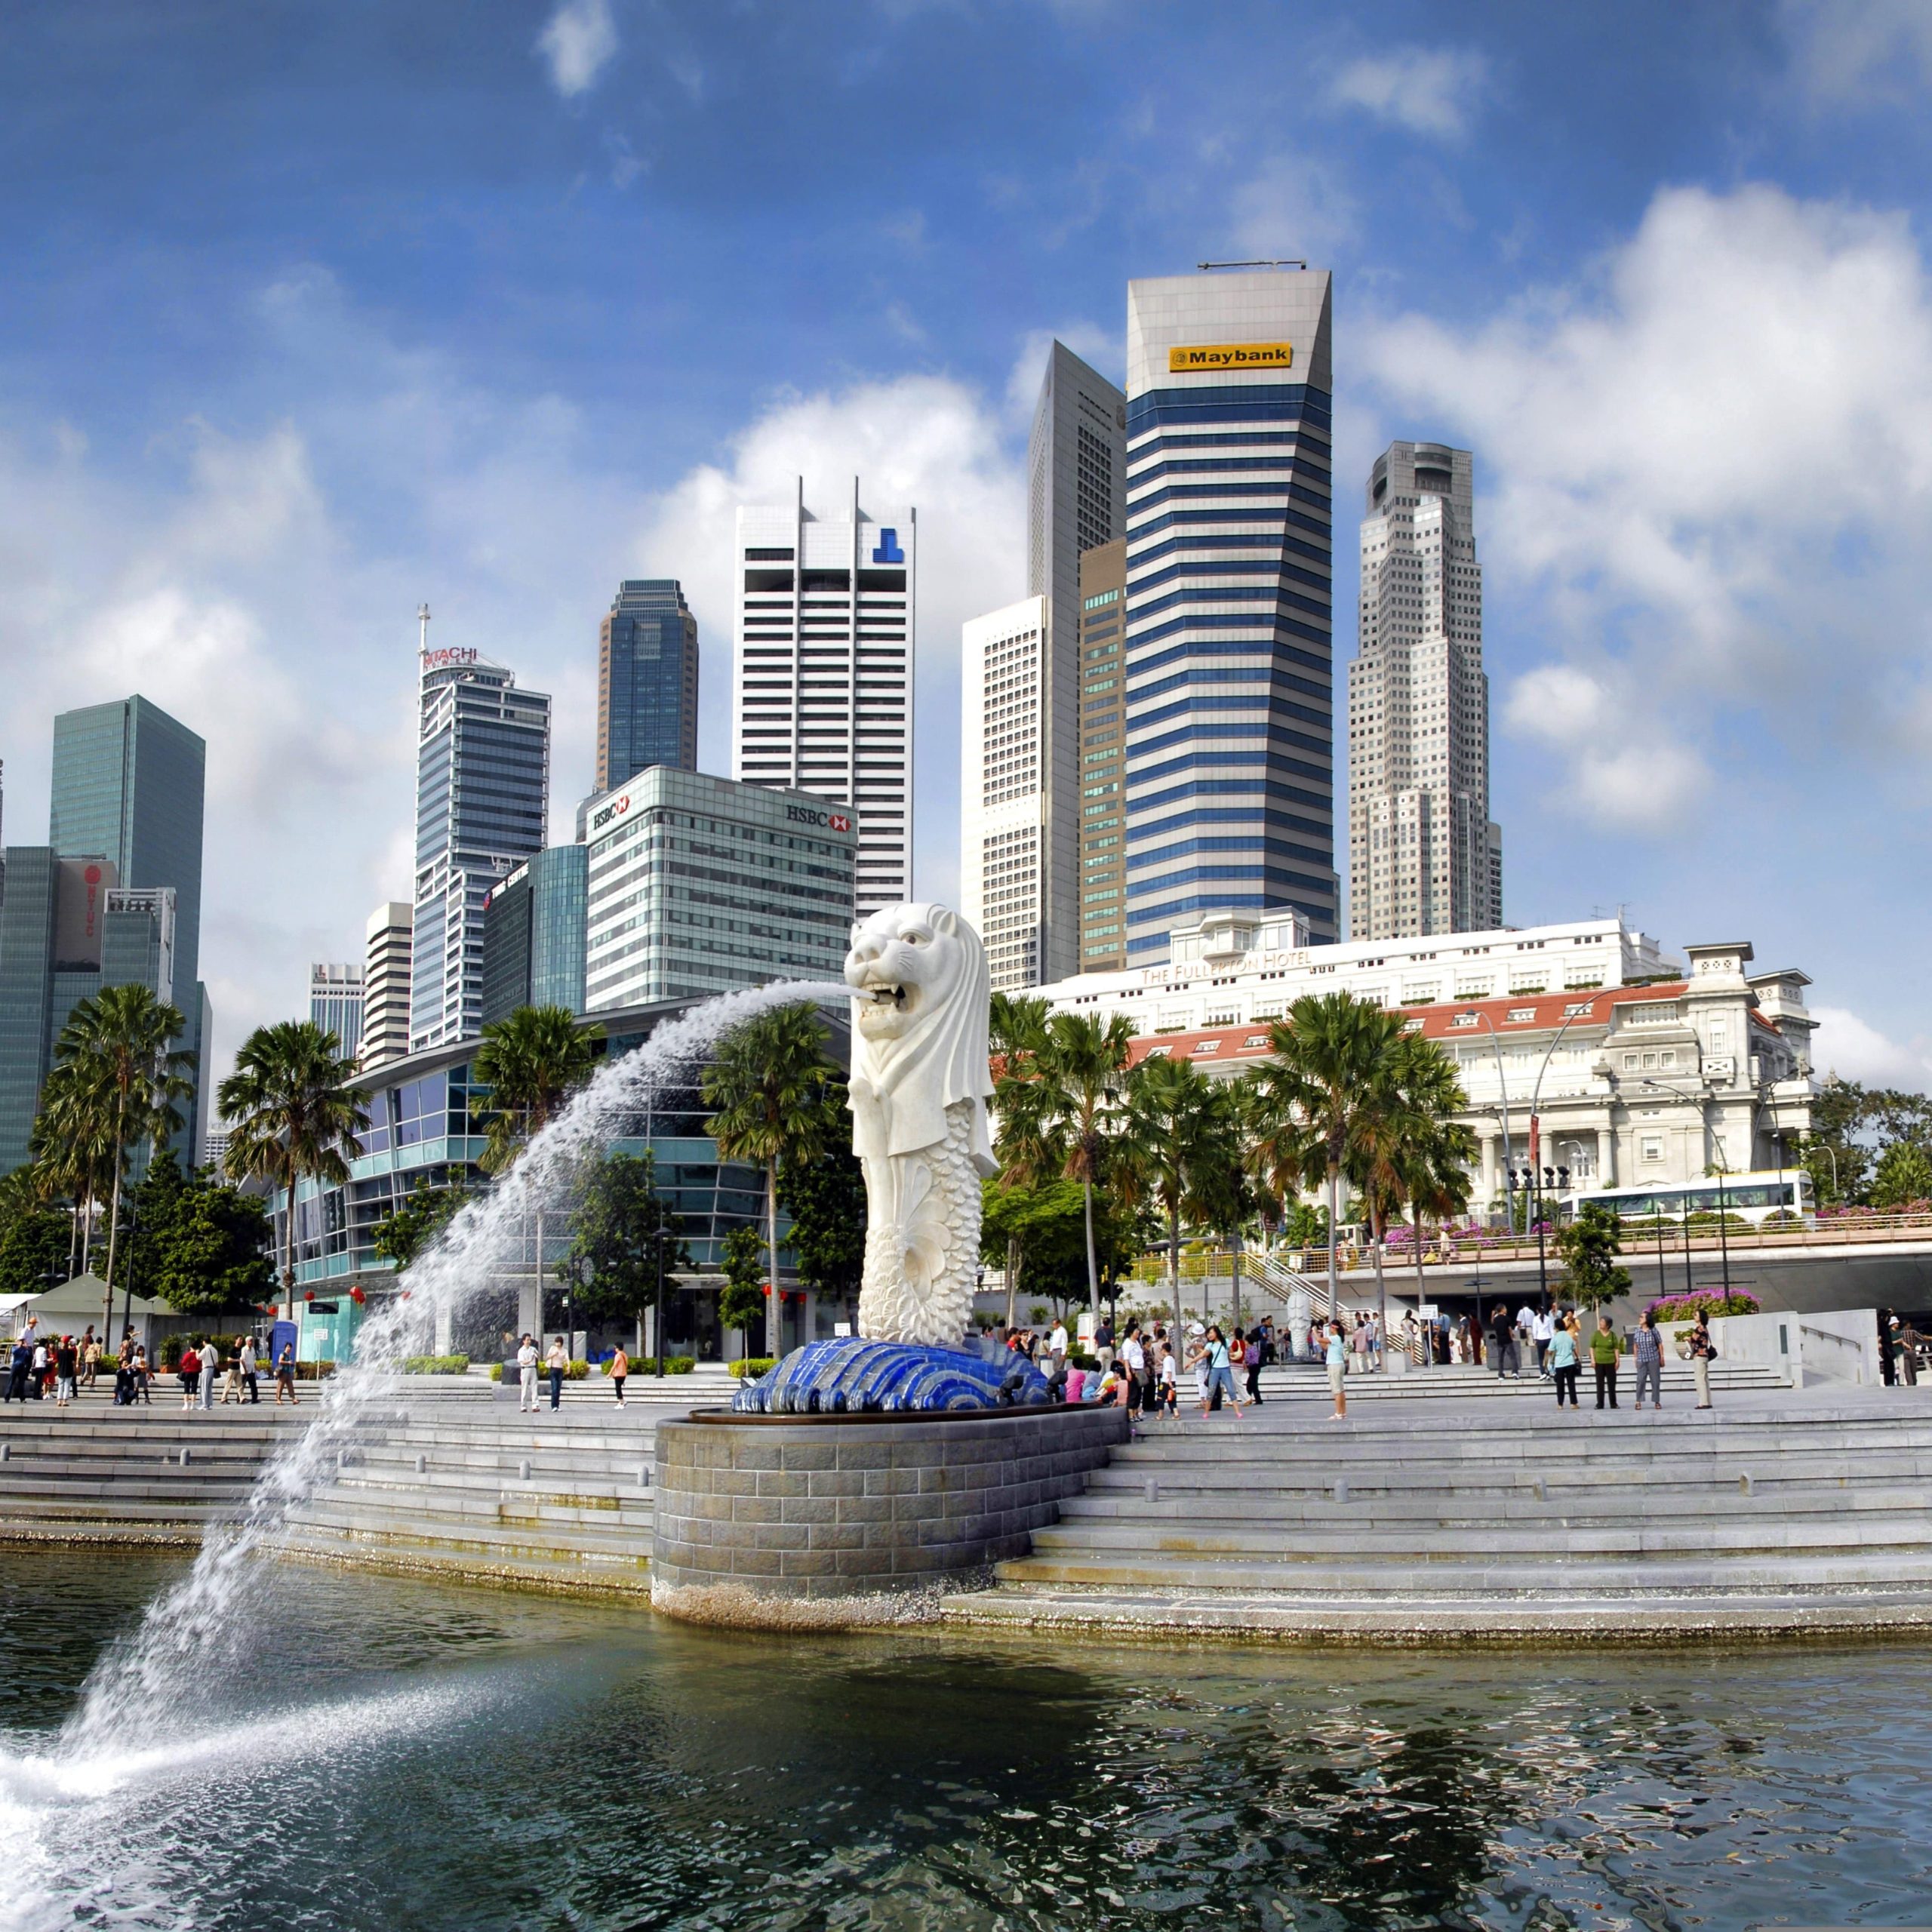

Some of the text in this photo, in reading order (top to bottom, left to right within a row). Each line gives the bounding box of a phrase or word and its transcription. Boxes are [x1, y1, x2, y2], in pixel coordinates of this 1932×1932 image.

[1189, 349, 1287, 365] Maybank
[594, 802, 617, 830] HSBC
[786, 804, 828, 827] HSBC
[1142, 951, 1312, 985] THE FULLERTON HOTEL
